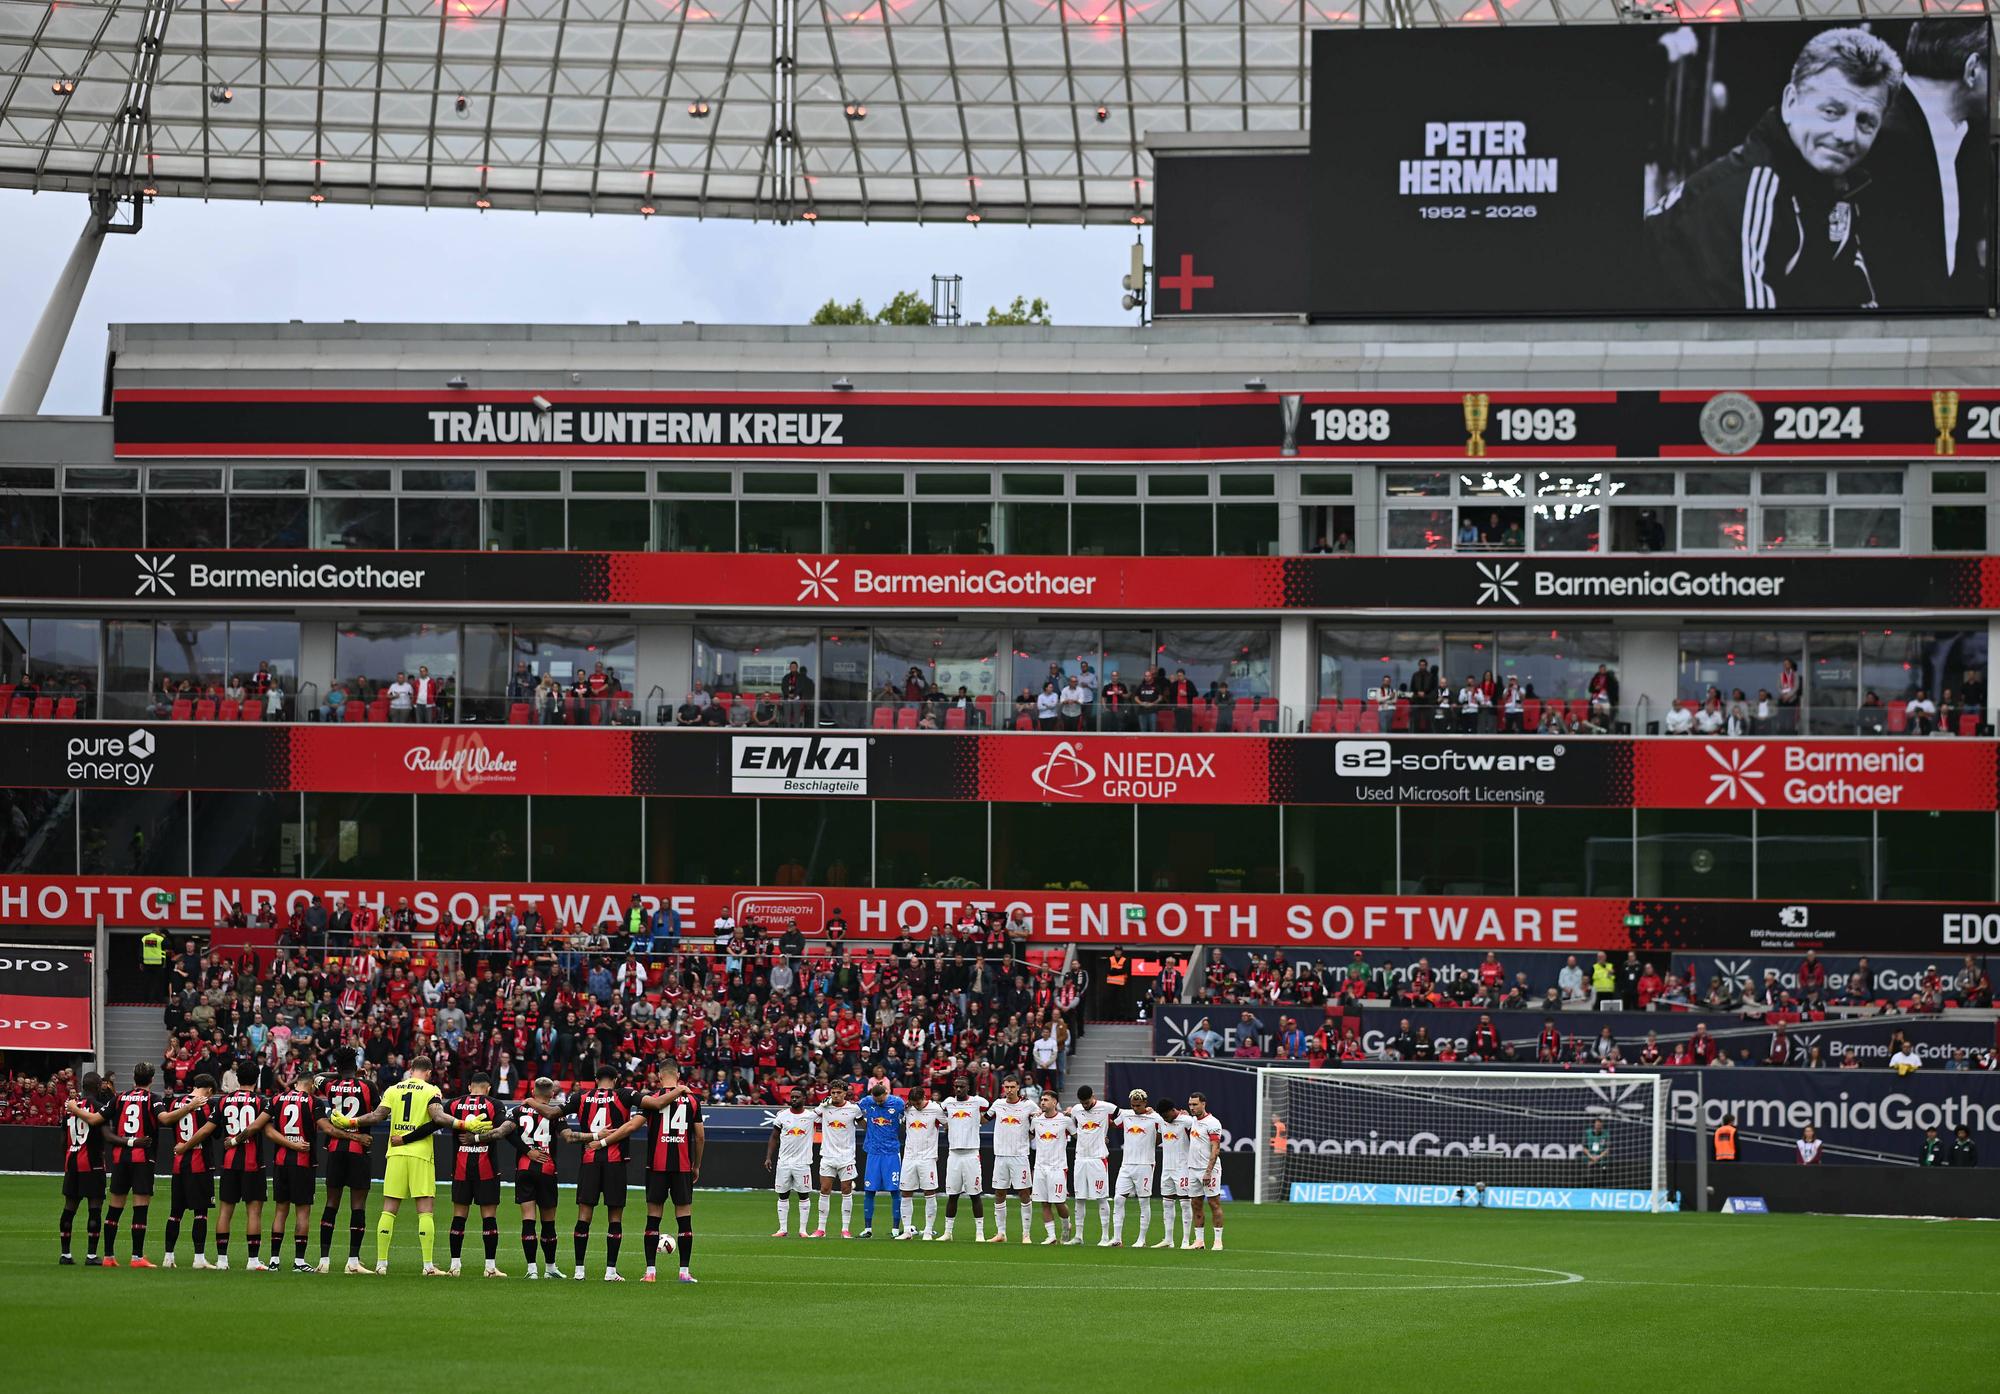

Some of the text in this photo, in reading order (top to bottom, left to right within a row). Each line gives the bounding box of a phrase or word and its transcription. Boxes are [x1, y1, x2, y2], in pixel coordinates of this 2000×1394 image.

[1425, 121, 1526, 156] PETER
[1399, 158, 1558, 194] HERMANN
[1419, 206, 1467, 218] 1952
[1485, 205, 1538, 218] 2026
[428, 405, 843, 444] TRÄUME UNTERM KREUZ
[1310, 408, 1390, 441] 1988
[1496, 408, 1577, 441] 1993
[1773, 406, 1864, 439] 2024
[190, 564, 425, 588] BarmeniaGothaer
[854, 569, 1096, 595] BarmeniaGothaer
[1535, 571, 1785, 597] BarmeniaGothaer
[67, 738, 124, 760] pure
[740, 738, 859, 778] EMKA
[1785, 746, 1924, 773] Barmenia
[67, 762, 154, 786] energy
[404, 746, 518, 781] Rudolf Weber
[1103, 752, 1216, 778] NIEDAX
[784, 780, 860, 793] Beschlagteile
[1103, 780, 1177, 798] GROUP
[1356, 786, 1545, 805] Used Microsoft Licensing
[1783, 778, 1903, 804] Gothaer
[1286, 905, 1579, 943] SOFTWARE
[1943, 913, 2000, 945] EDO
[330, 1085, 352, 1093] BAYER
[586, 1096, 607, 1104] BAYER
[123, 1104, 140, 1134] 3
[283, 1104, 300, 1135] 2
[331, 1096, 360, 1119] 12
[401, 1091, 413, 1122] 1
[660, 1104, 689, 1135] 14
[67, 1116, 90, 1146] 19
[179, 1112, 194, 1142] 9
[224, 1105, 256, 1136] 30
[519, 1116, 551, 1148] 24
[590, 1108, 609, 1133] 4
[660, 1136, 686, 1144] SCHICK
[1055, 1184, 1063, 1194] 10
[1180, 1177, 1189, 1187] 28
[1293, 1184, 1377, 1202] NIEDAX
[1488, 1189, 1572, 1208] NIEDAX
